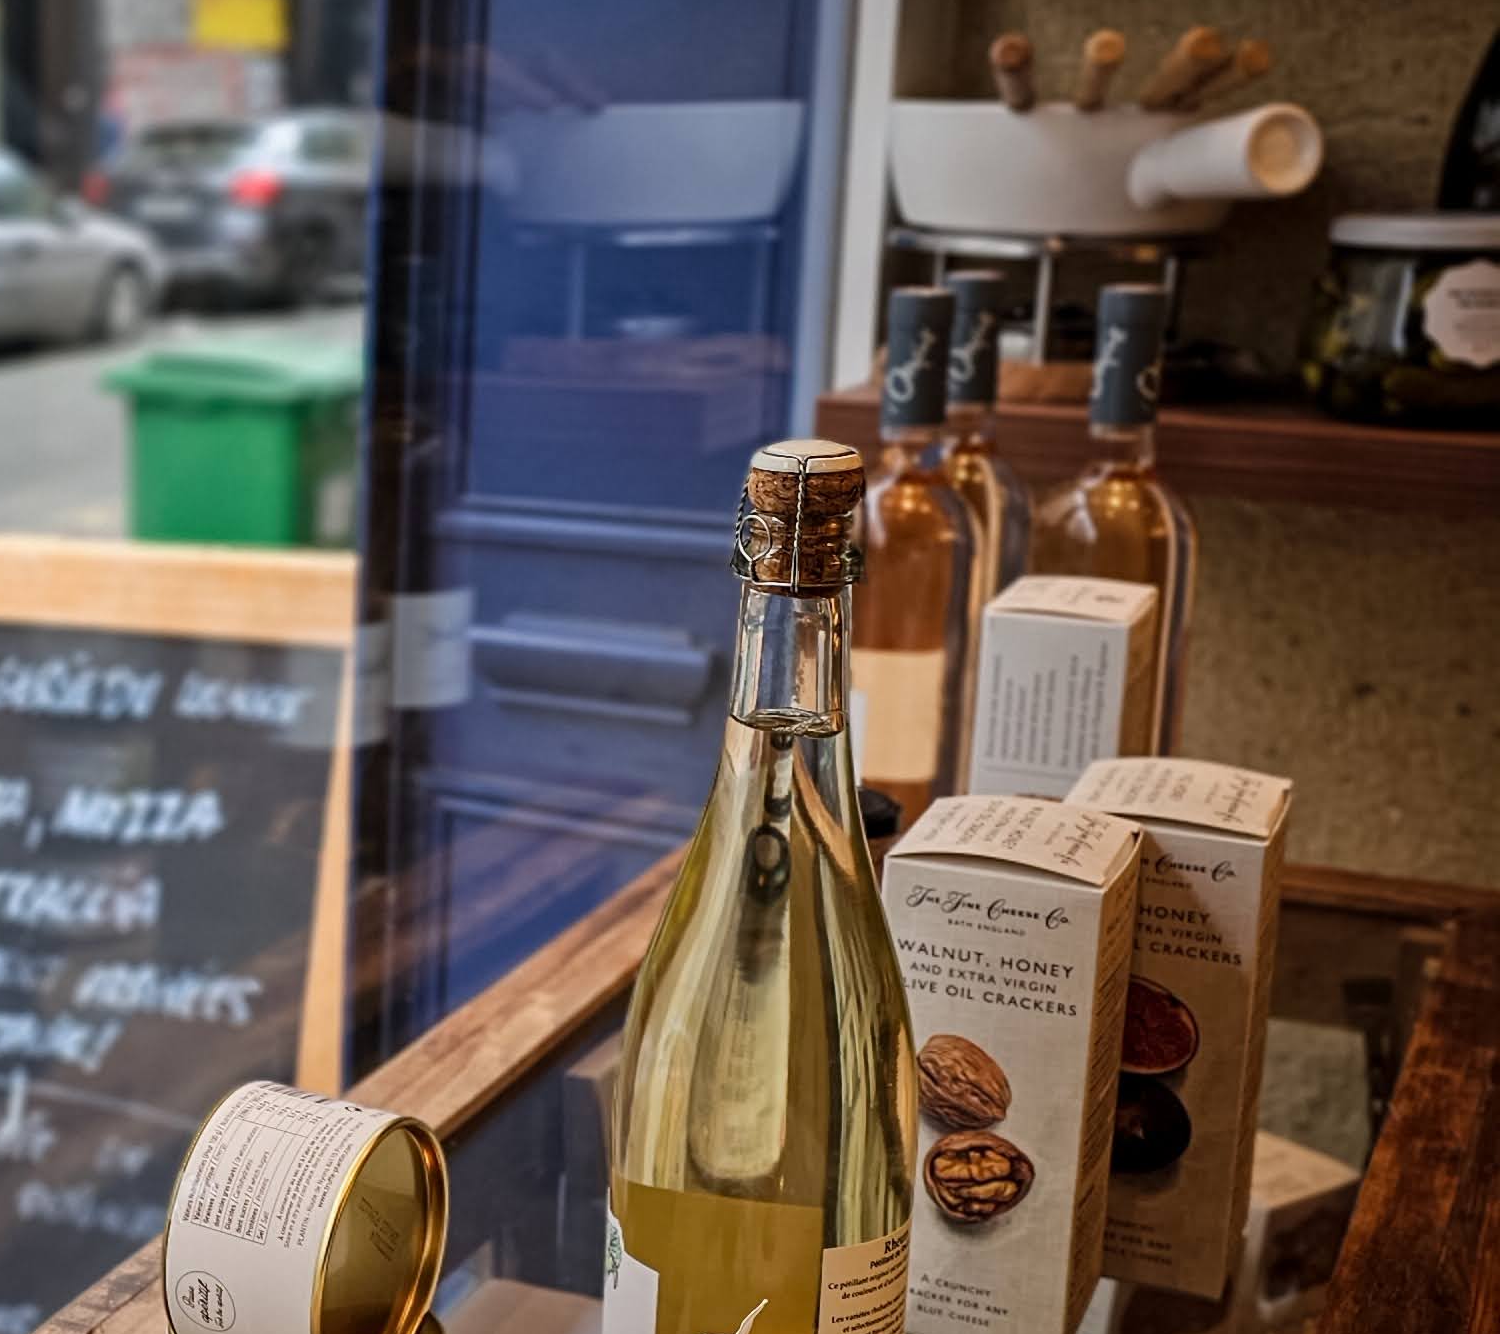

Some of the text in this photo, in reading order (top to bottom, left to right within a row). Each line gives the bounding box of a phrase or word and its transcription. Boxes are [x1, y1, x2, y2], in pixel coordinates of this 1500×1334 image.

[1138, 903, 1211, 925] HONEY
[1136, 921, 1222, 944] TRA VIRGIN
[1148, 941, 1243, 966] CRACKERS
[909, 960, 1058, 995] AND EXTRA VIRGIN
[999, 956, 1075, 980] HONEY
[900, 977, 1078, 1017] LIVE OIL CRACKERS
[920, 1273, 993, 1297] A CRUNCHY
[908, 1287, 1010, 1317] RACKER FOR ANY
[915, 1302, 990, 1327] BLUE CHEESE
